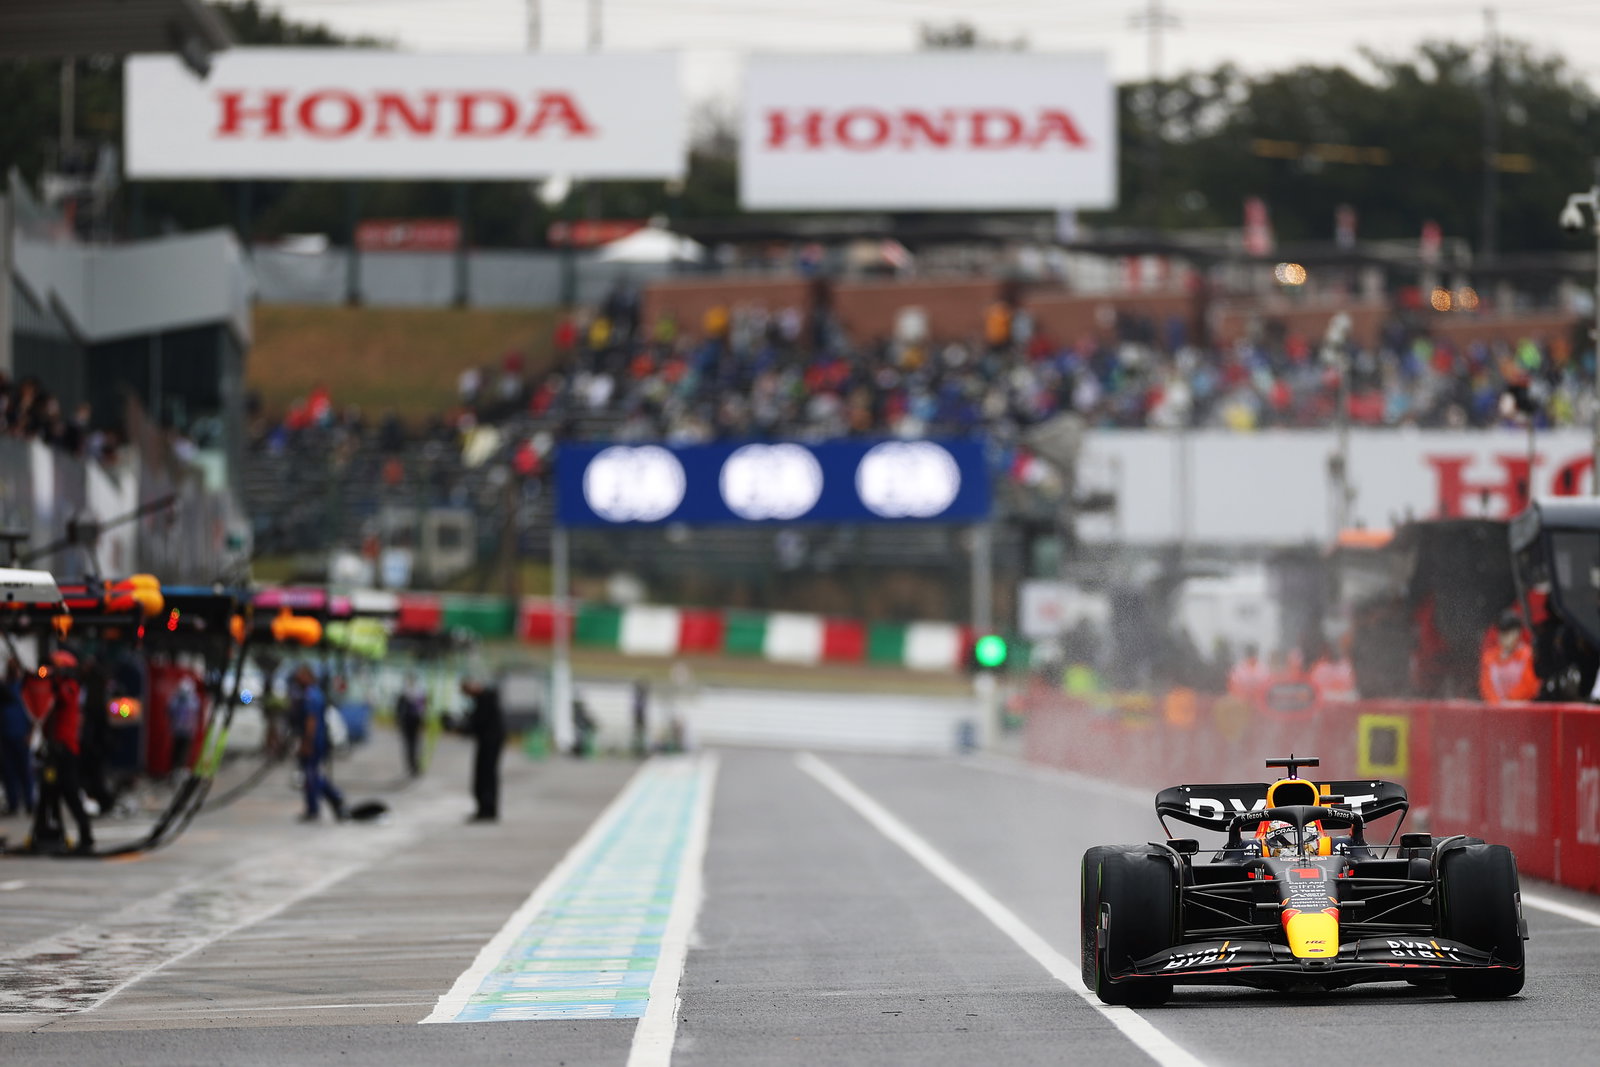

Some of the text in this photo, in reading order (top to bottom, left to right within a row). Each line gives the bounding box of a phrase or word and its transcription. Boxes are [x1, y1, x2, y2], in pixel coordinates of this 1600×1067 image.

[215, 90, 598, 138] HONDA
[764, 107, 1092, 150] HONDA
[1333, 810, 1350, 819] Tezos
[1275, 826, 1297, 836] ORAC
[1290, 868, 1319, 878] 1
